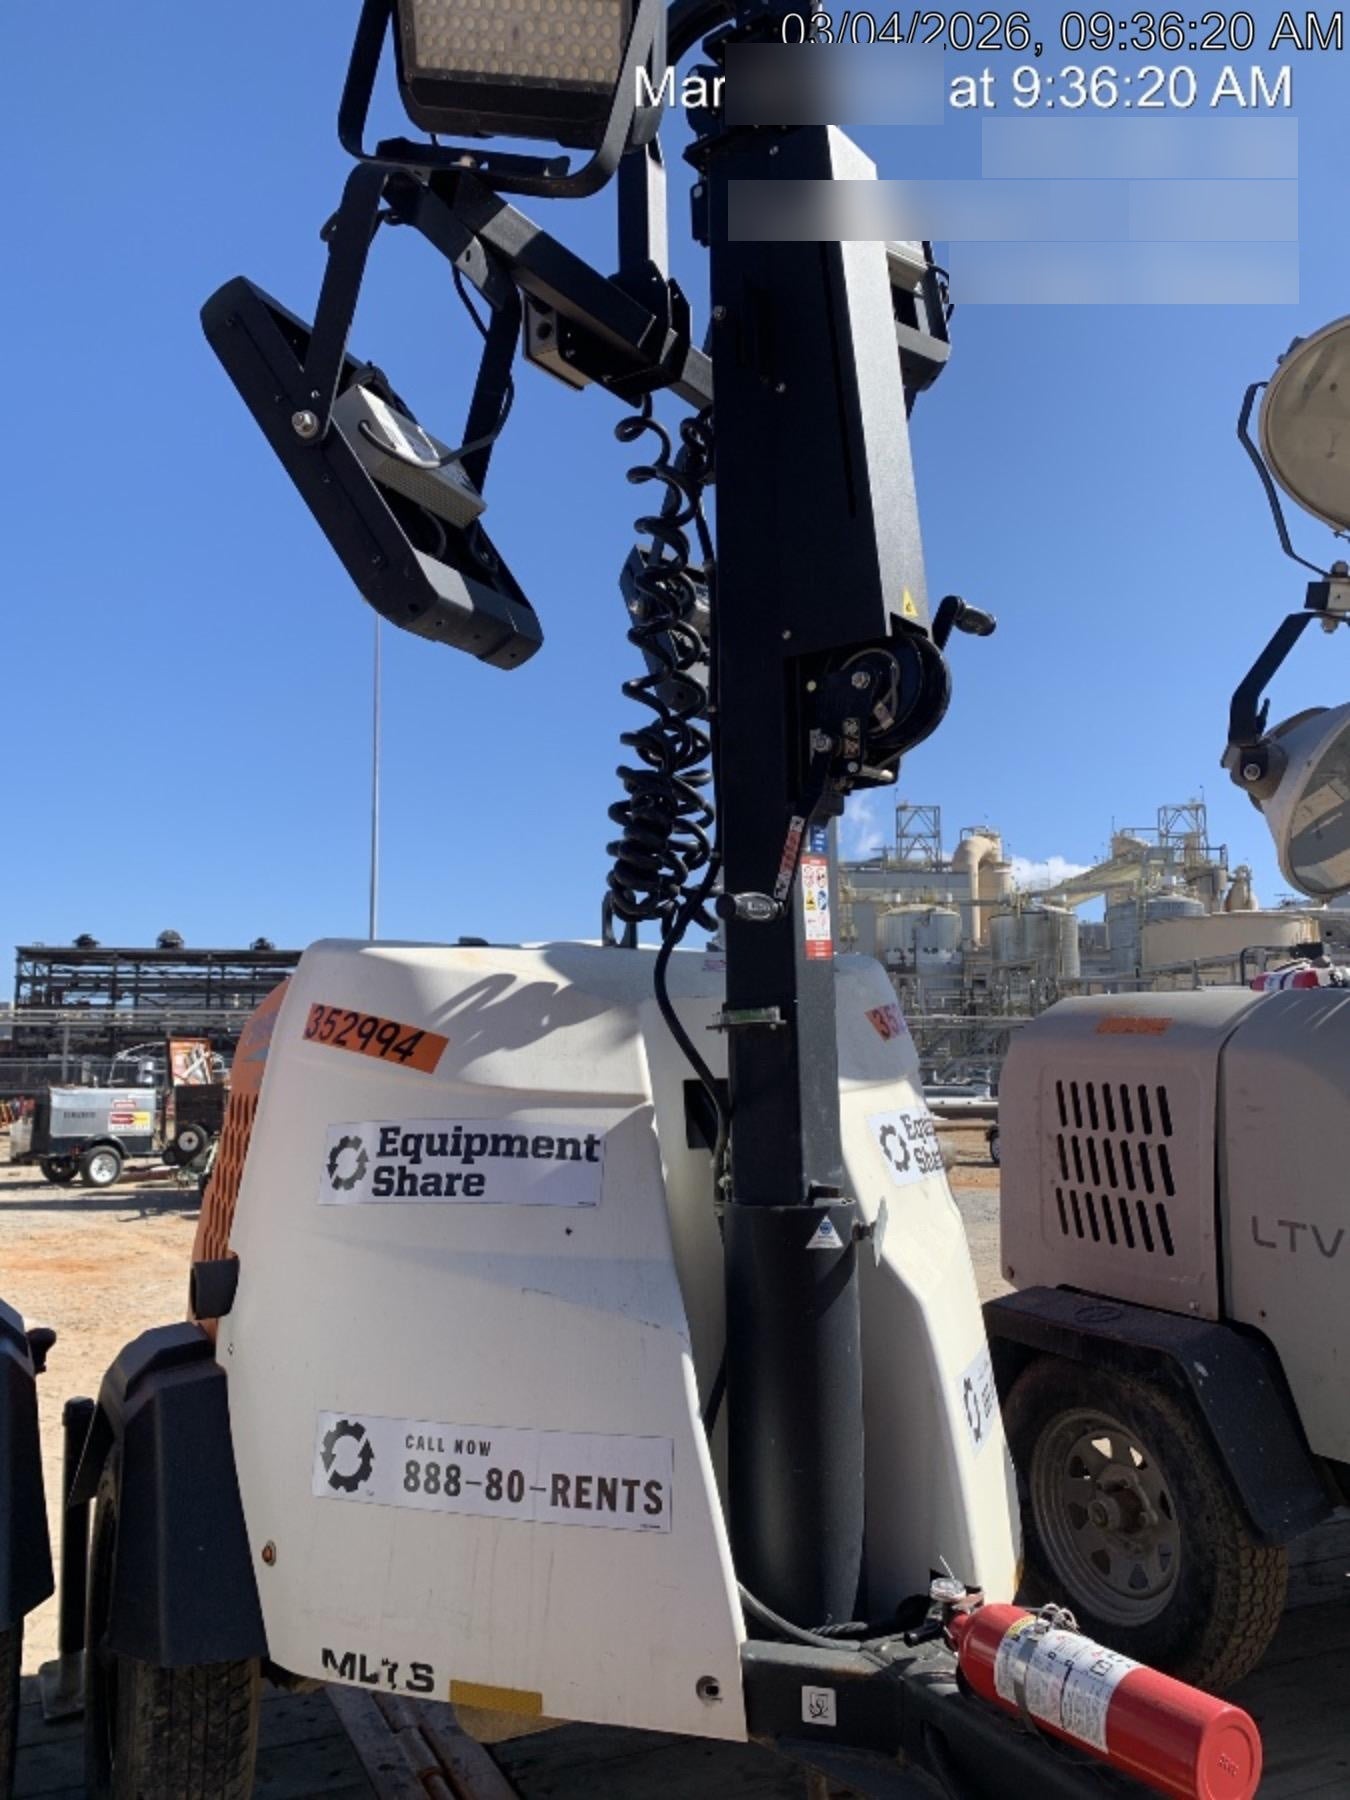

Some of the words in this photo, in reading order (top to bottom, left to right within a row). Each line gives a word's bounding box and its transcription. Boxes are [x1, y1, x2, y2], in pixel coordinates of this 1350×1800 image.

[304, 1004, 426, 1062] 352994
[376, 1126, 600, 1164] Equipment
[372, 1165, 485, 1197] Share
[1252, 1215, 1345, 1258] LTV
[405, 1434, 445, 1453] CALL
[454, 1440, 491, 1457] NOW
[403, 1460, 663, 1515] 888-80-RENTS
